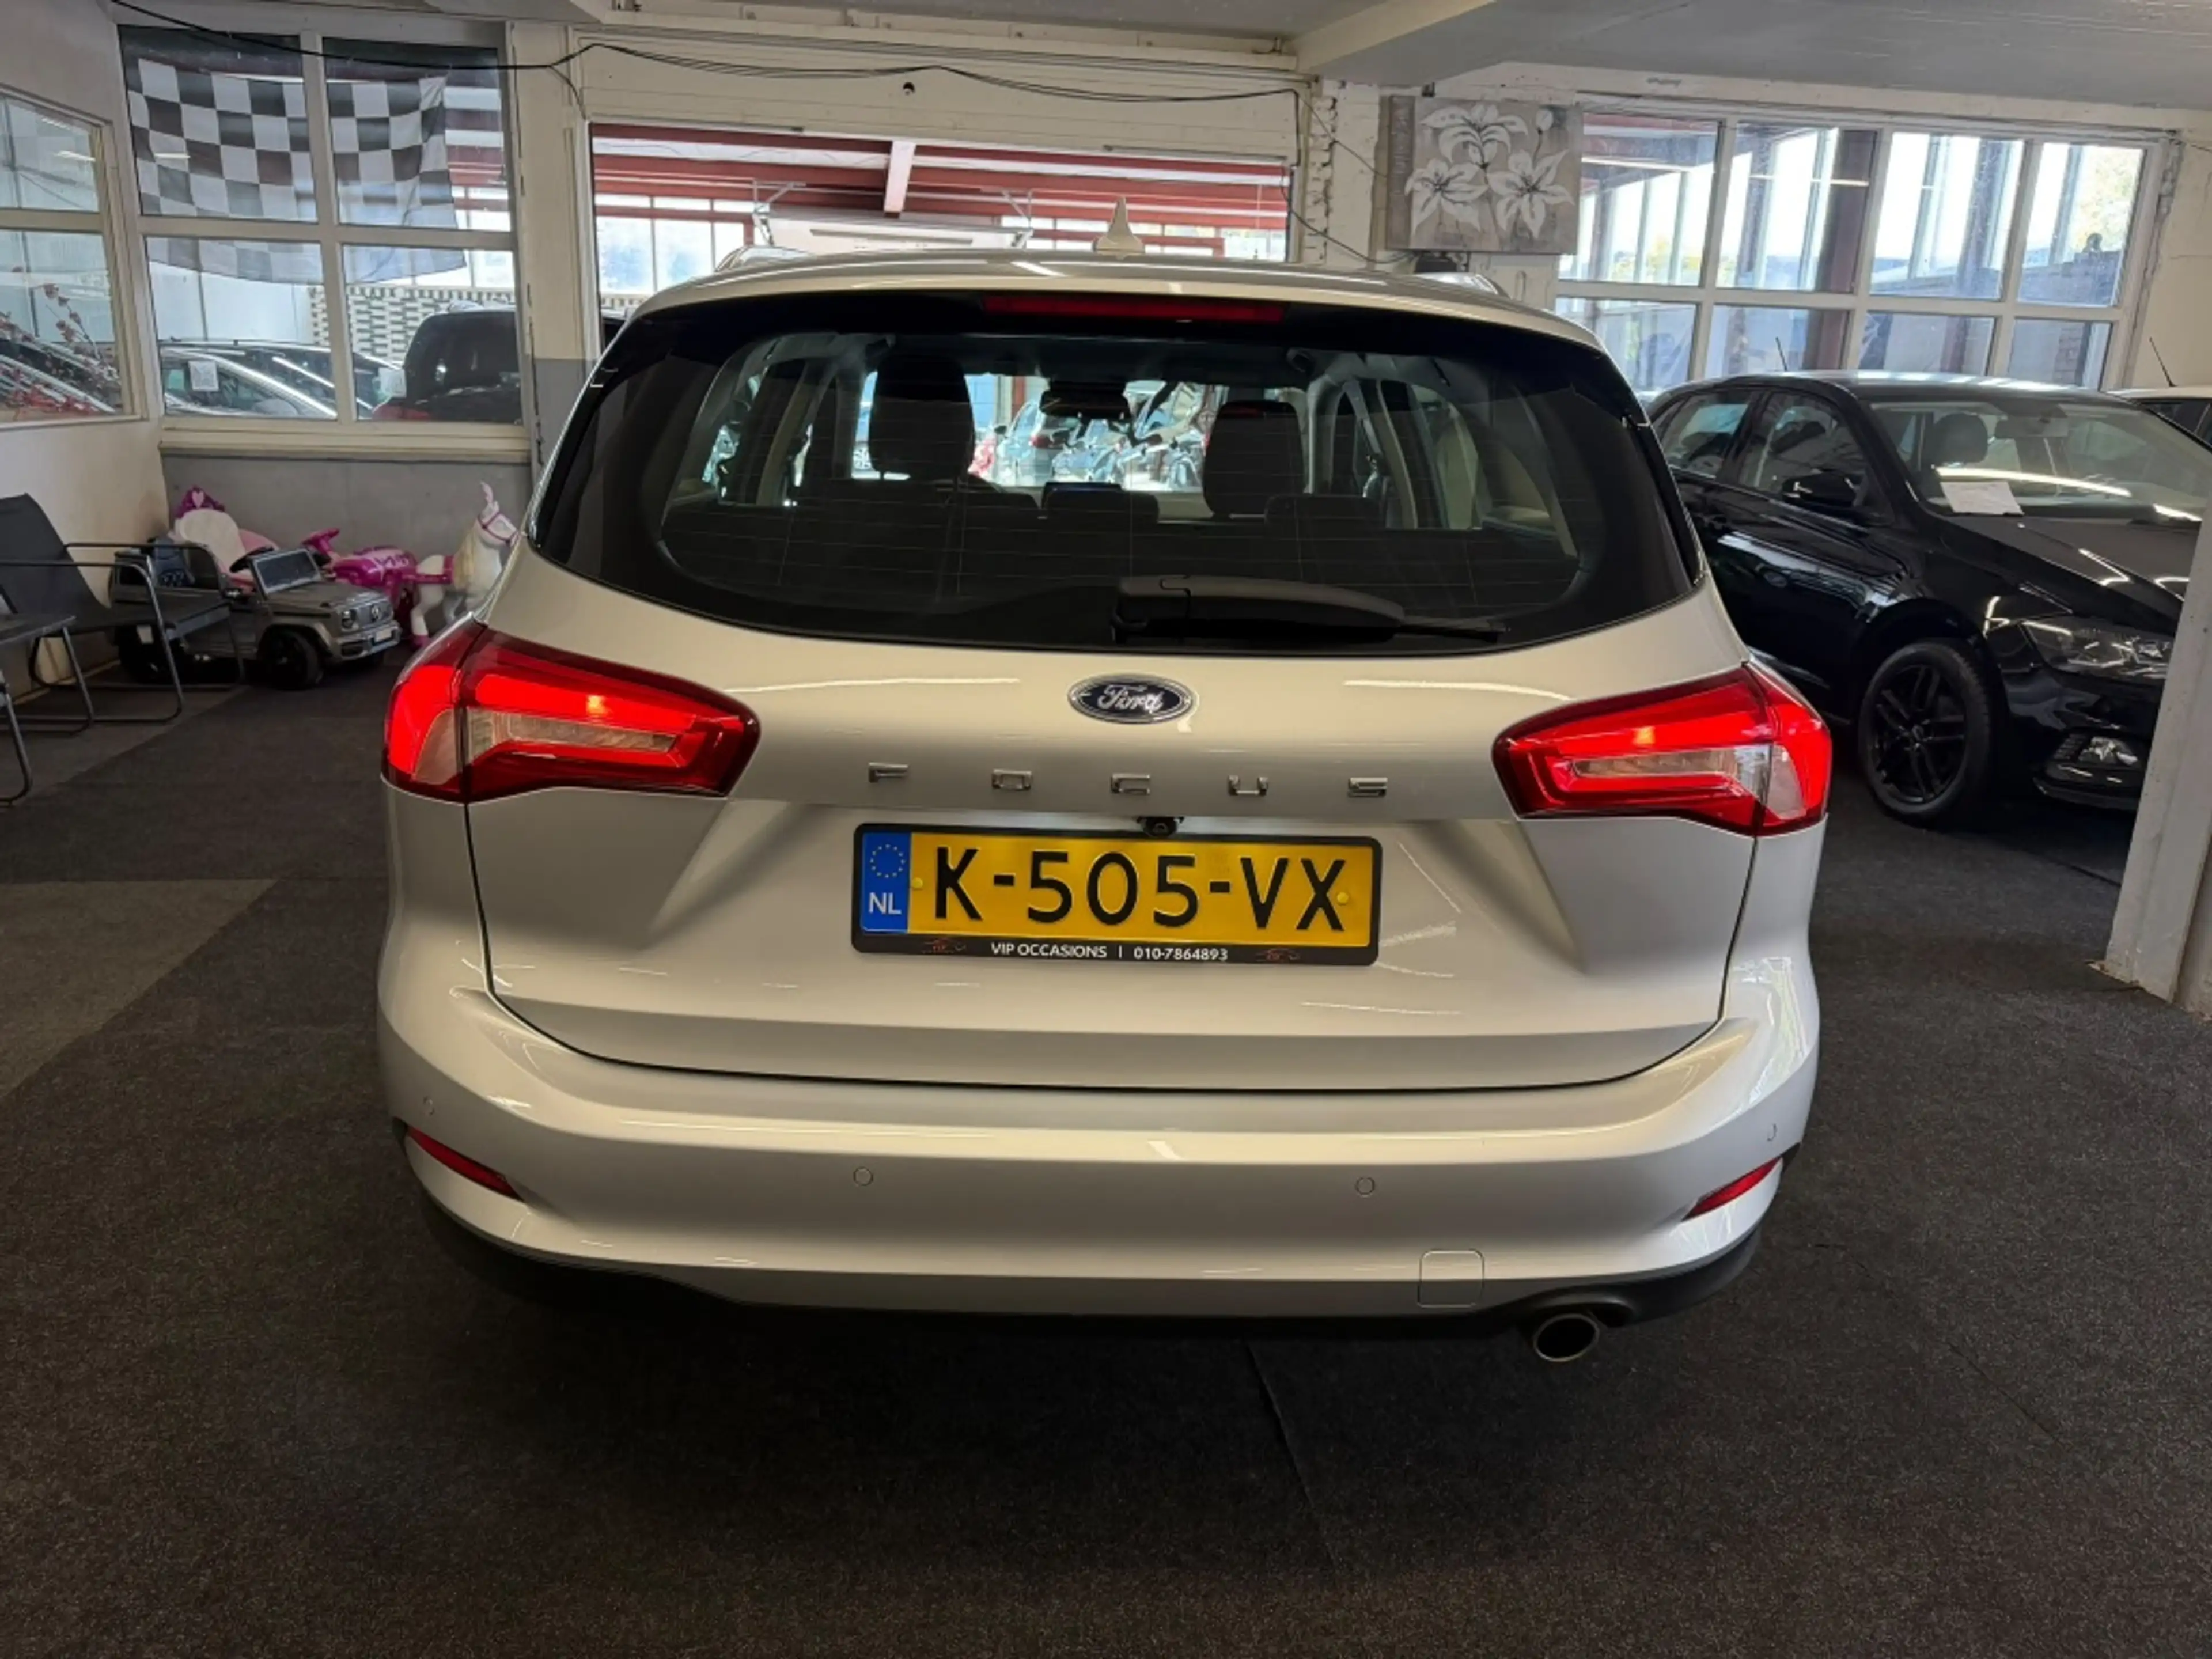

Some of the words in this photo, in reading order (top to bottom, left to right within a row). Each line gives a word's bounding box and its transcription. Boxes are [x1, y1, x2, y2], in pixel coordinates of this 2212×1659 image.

[1097, 684, 1165, 714] Ford
[934, 846, 1347, 932] K-505-VX
[868, 892, 902, 915] NL
[991, 942, 1014, 955] VIP
[1017, 944, 1107, 959] OCCASIONS
[1134, 946, 1229, 961] 010-7864893
